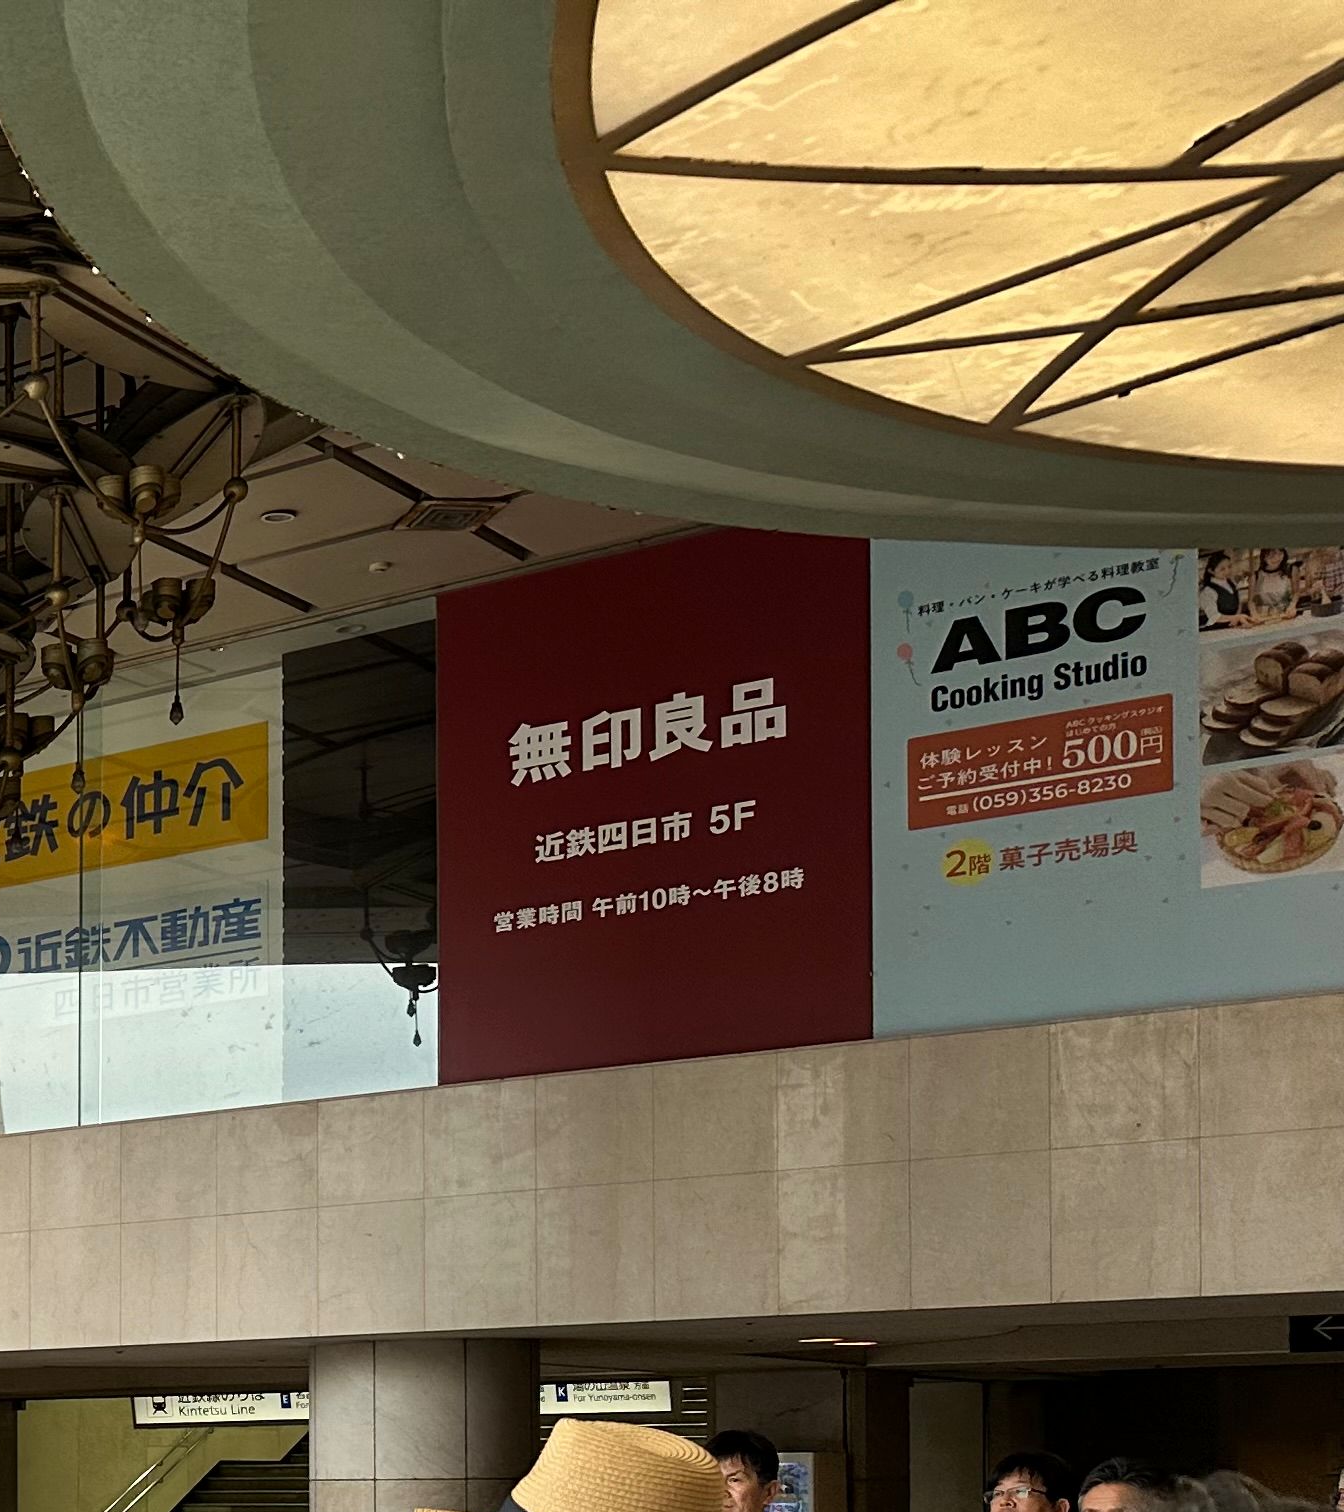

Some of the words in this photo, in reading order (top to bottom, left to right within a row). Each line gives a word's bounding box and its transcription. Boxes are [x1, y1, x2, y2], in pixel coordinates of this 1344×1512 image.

[930, 586, 1147, 674] ABC
[930, 673, 1044, 713] Cooking
[1053, 651, 1148, 692] Studio
[508, 677, 787, 787] 無印良品
[919, 735, 1048, 769] 体験レッスン
[972, 773, 1133, 814] (059)356-8230
[534, 811, 693, 864] 近鉄四日市
[709, 800, 757, 835] 5F
[945, 849, 992, 878] 2階
[998, 829, 1139, 872] 菓子売場奥
[17, 897, 263, 974] 近鉄不動産
[493, 899, 583, 933] 営業時間
[178, 1404, 227, 1416] Kintetsu
[231, 1404, 256, 1415] Line
